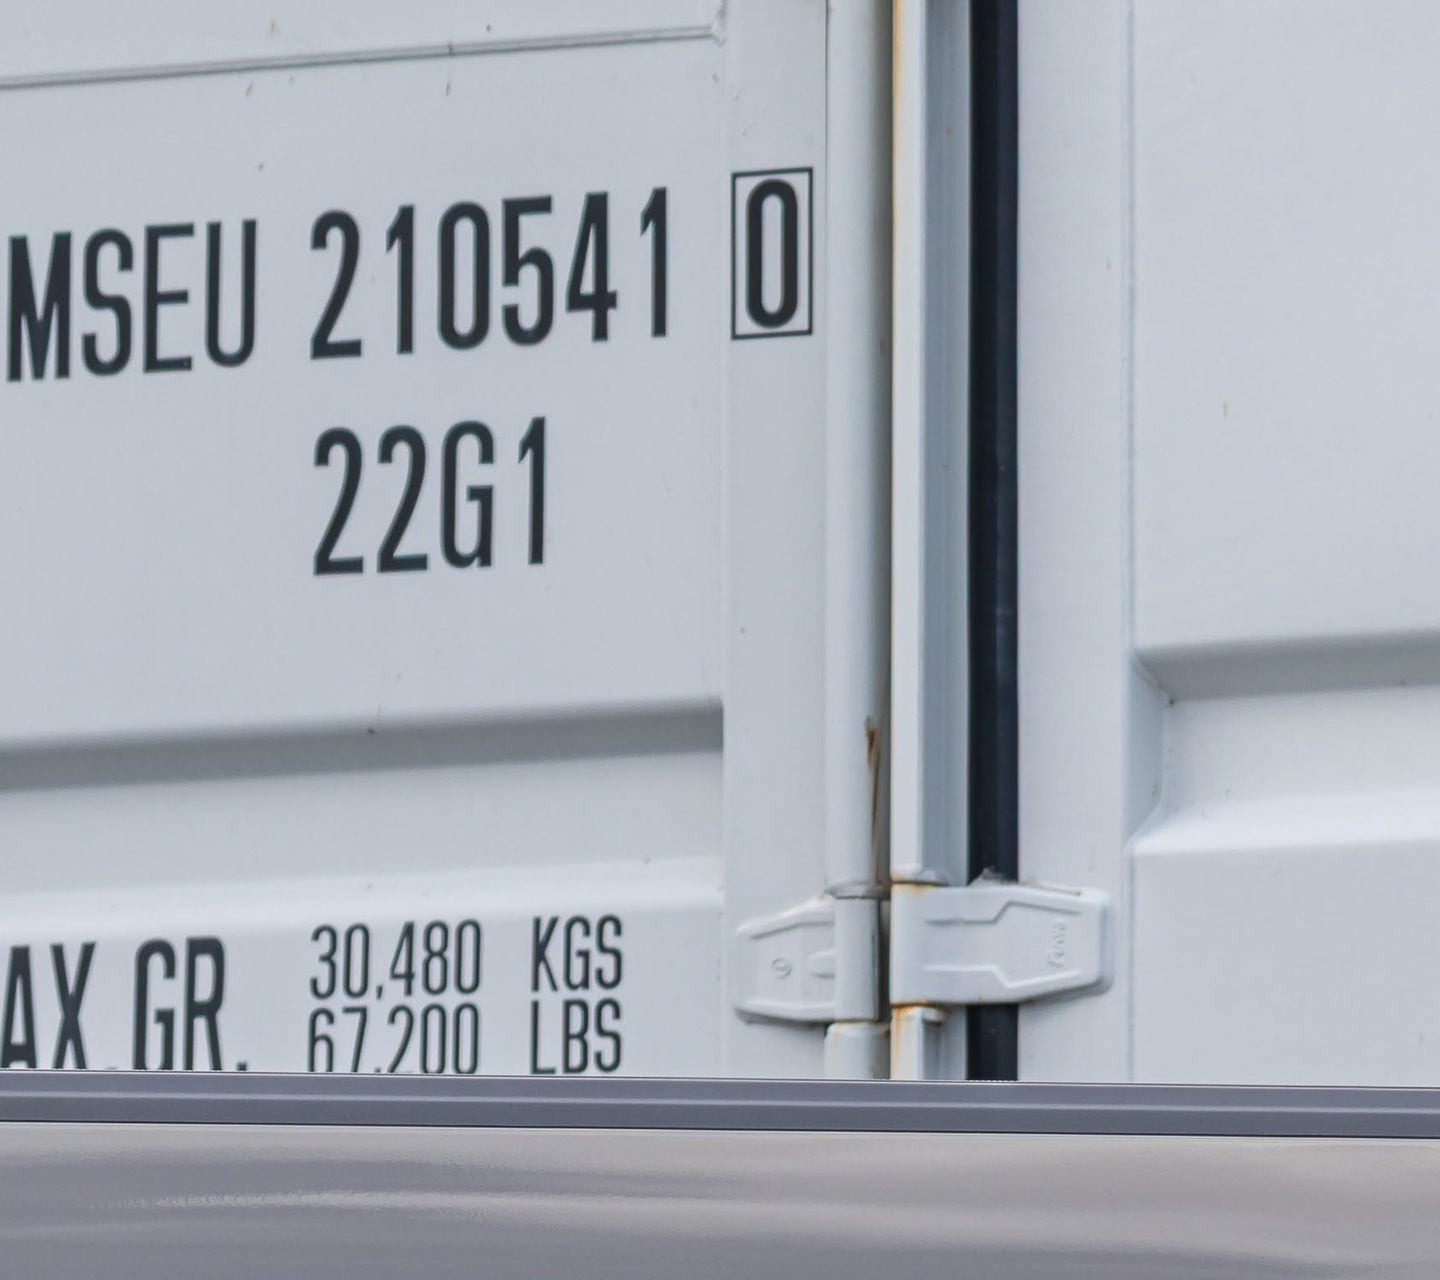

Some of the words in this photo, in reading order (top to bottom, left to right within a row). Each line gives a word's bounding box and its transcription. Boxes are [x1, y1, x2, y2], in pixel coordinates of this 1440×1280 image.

[6, 218, 259, 383] MSEU
[309, 186, 670, 360] 210541
[313, 416, 549, 576] 22G1
[132, 936, 248, 1072] GR.
[309, 918, 481, 1001] 30,480
[530, 914, 623, 992] KGS
[530, 997, 622, 1075] LBS
